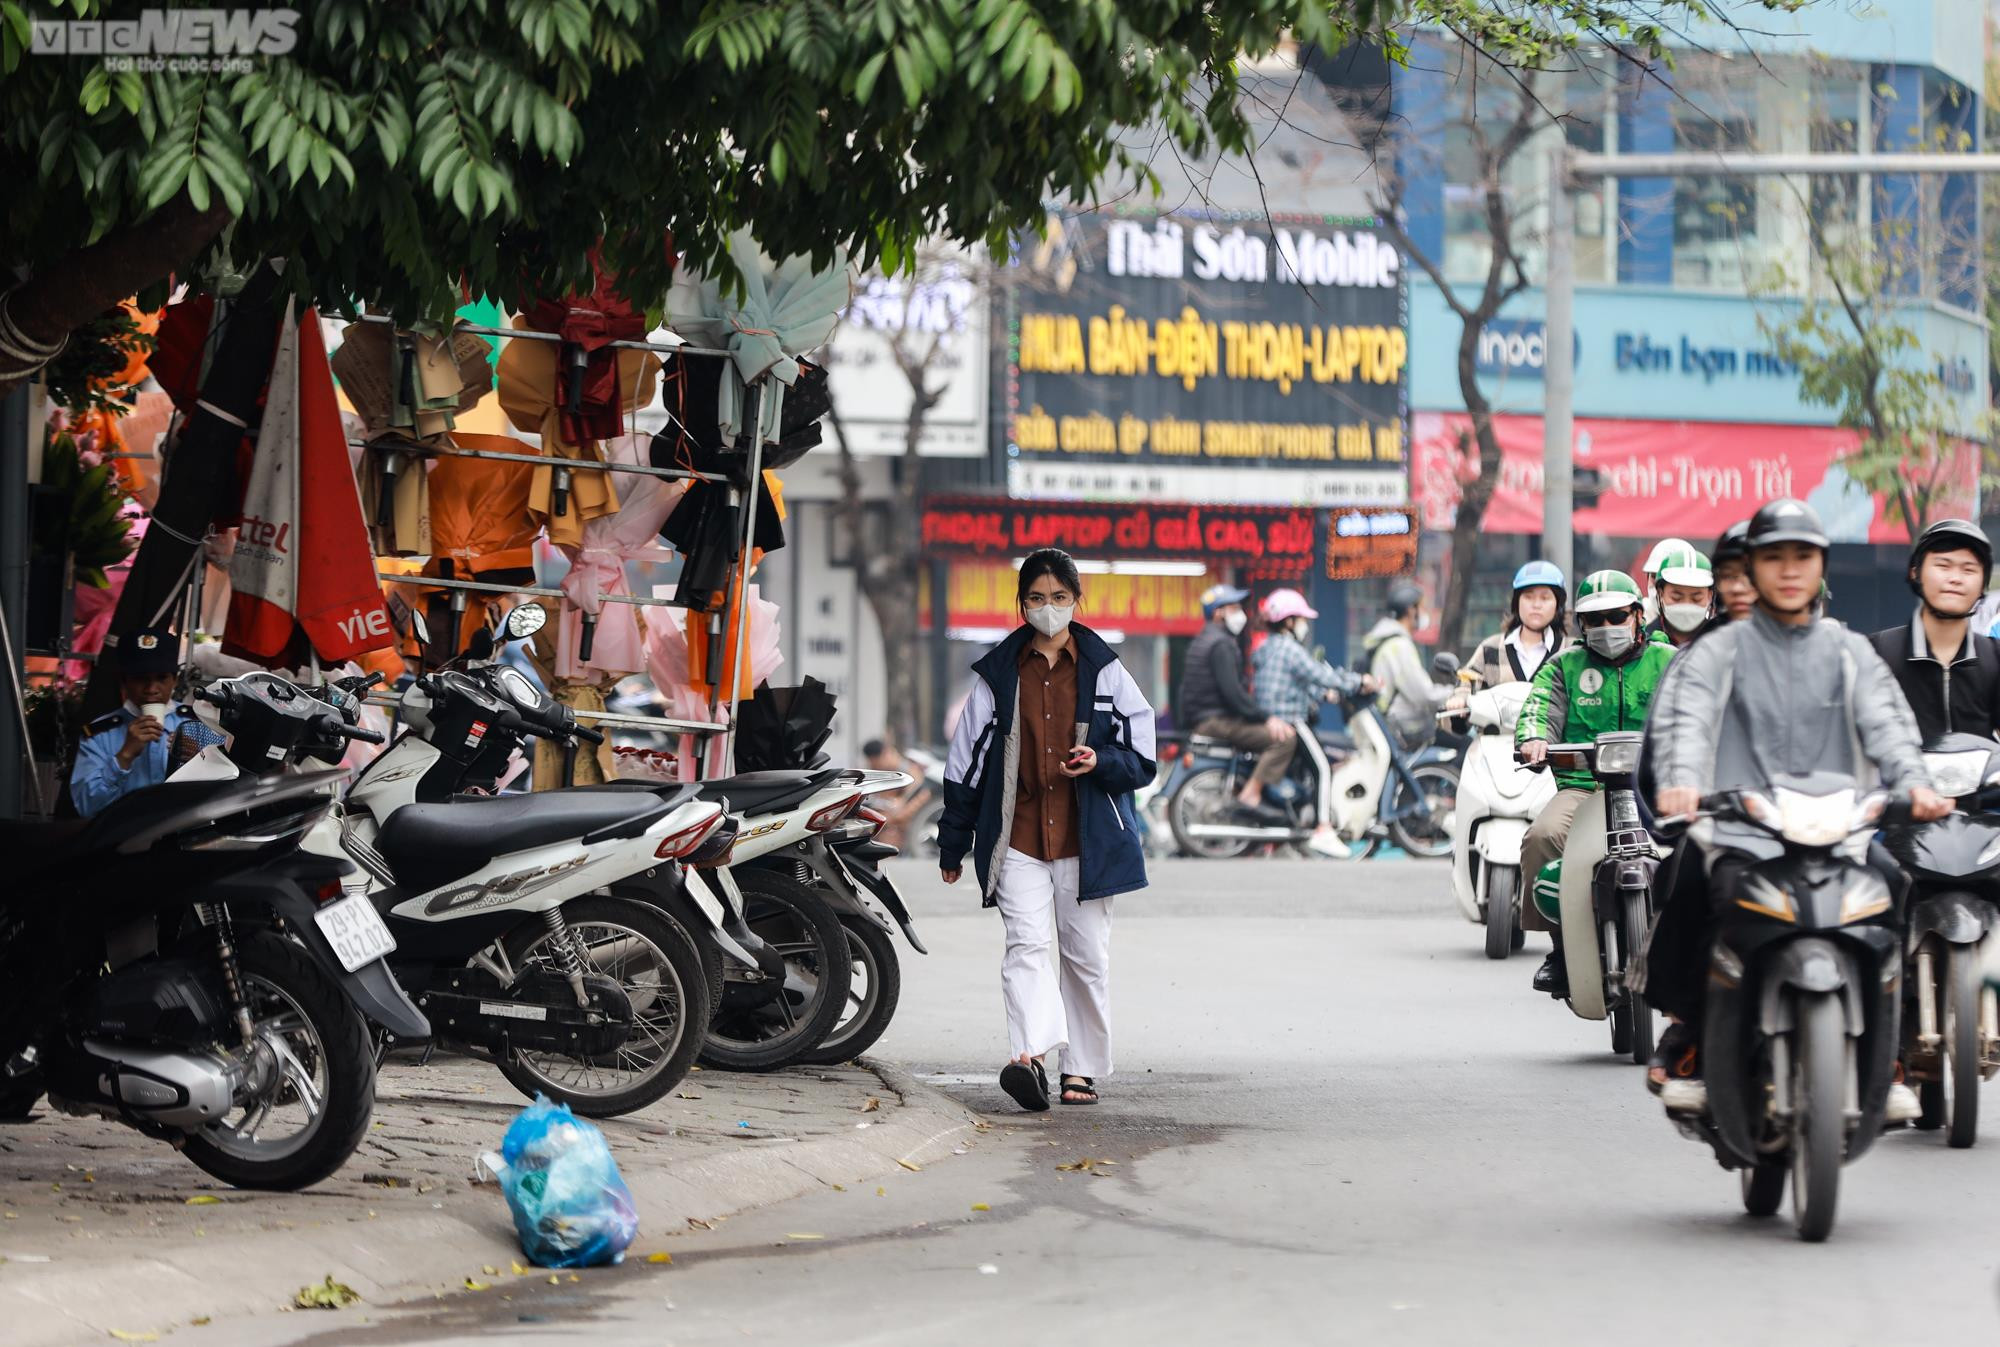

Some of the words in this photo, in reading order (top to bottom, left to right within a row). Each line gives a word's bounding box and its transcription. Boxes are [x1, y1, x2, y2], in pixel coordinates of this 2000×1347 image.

[1107, 217, 1183, 278] Thái
[1275, 227, 1399, 288] Mobile
[1019, 313, 1085, 373] MUA
[1680, 334, 1737, 386] bạn
[1202, 419, 1336, 461] SMARTPHONE
[1671, 455, 1743, 508] Trọn
[1013, 514, 1112, 548] LAPTOP
[336, 604, 391, 645] vie
[1577, 696, 1603, 707] Grab
